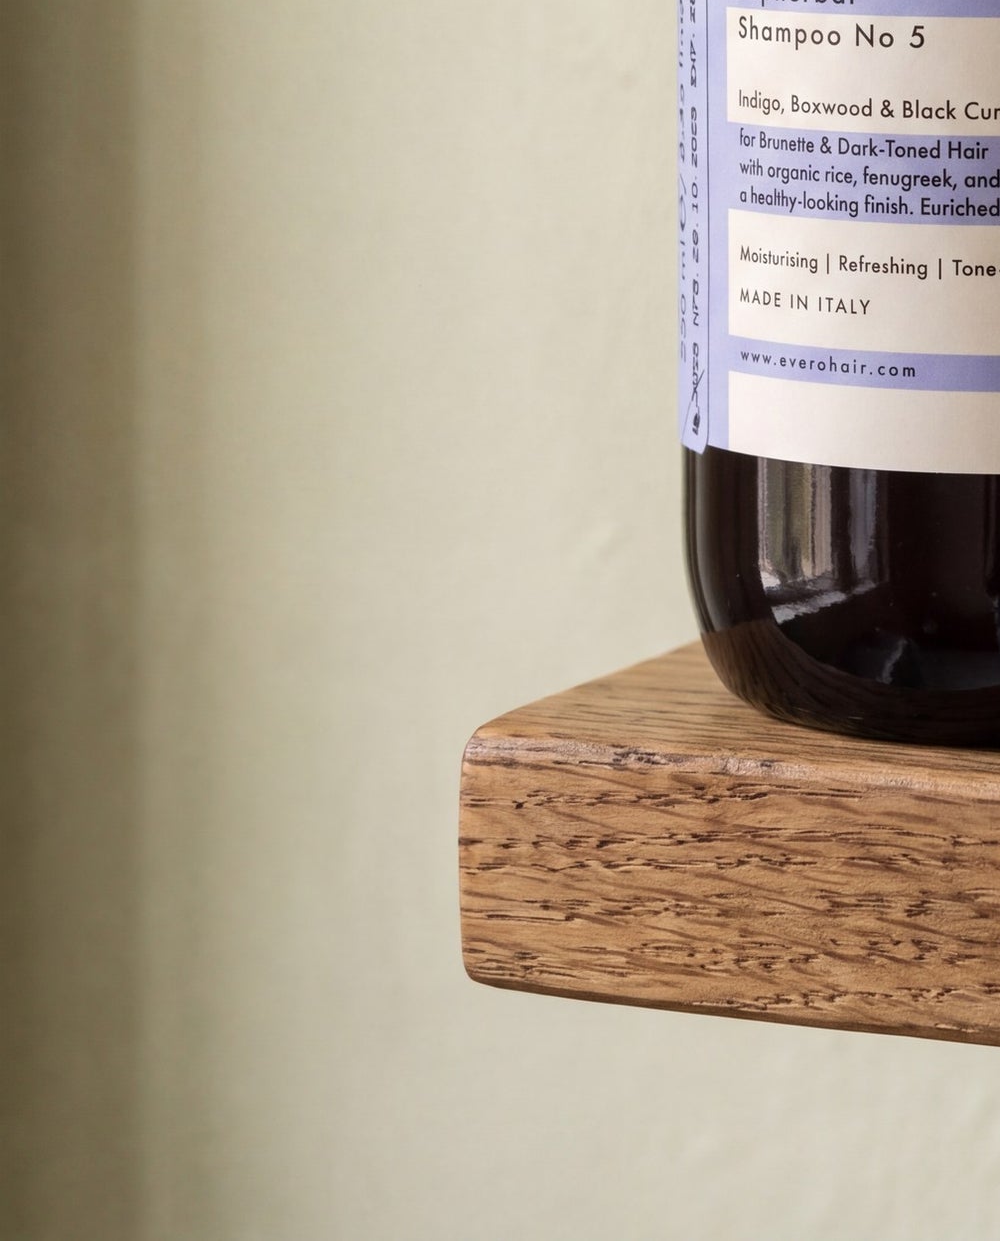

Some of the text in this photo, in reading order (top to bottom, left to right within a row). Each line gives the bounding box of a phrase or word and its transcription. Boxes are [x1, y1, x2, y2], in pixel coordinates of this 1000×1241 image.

[739, 15, 924, 50] Shampoo No 5
[739, 90, 784, 115] Indigo,
[792, 95, 872, 117] Boxwood
[881, 100, 894, 118] &
[903, 99, 956, 119] Black
[740, 128, 989, 159] for Brunette & Dark-Toned Hair
[740, 158, 763, 176] with
[768, 164, 820, 184] organic
[825, 166, 857, 186] rice,
[863, 166, 957, 191] fenugreek,
[964, 169, 1000, 188] and
[740, 191, 747, 202] a
[751, 185, 858, 218] healthy-looking
[864, 194, 913, 215] finish.
[740, 246, 817, 274] Moisturising
[840, 255, 927, 280] Refreshing
[740, 288, 870, 314] MADE IN ITALY
